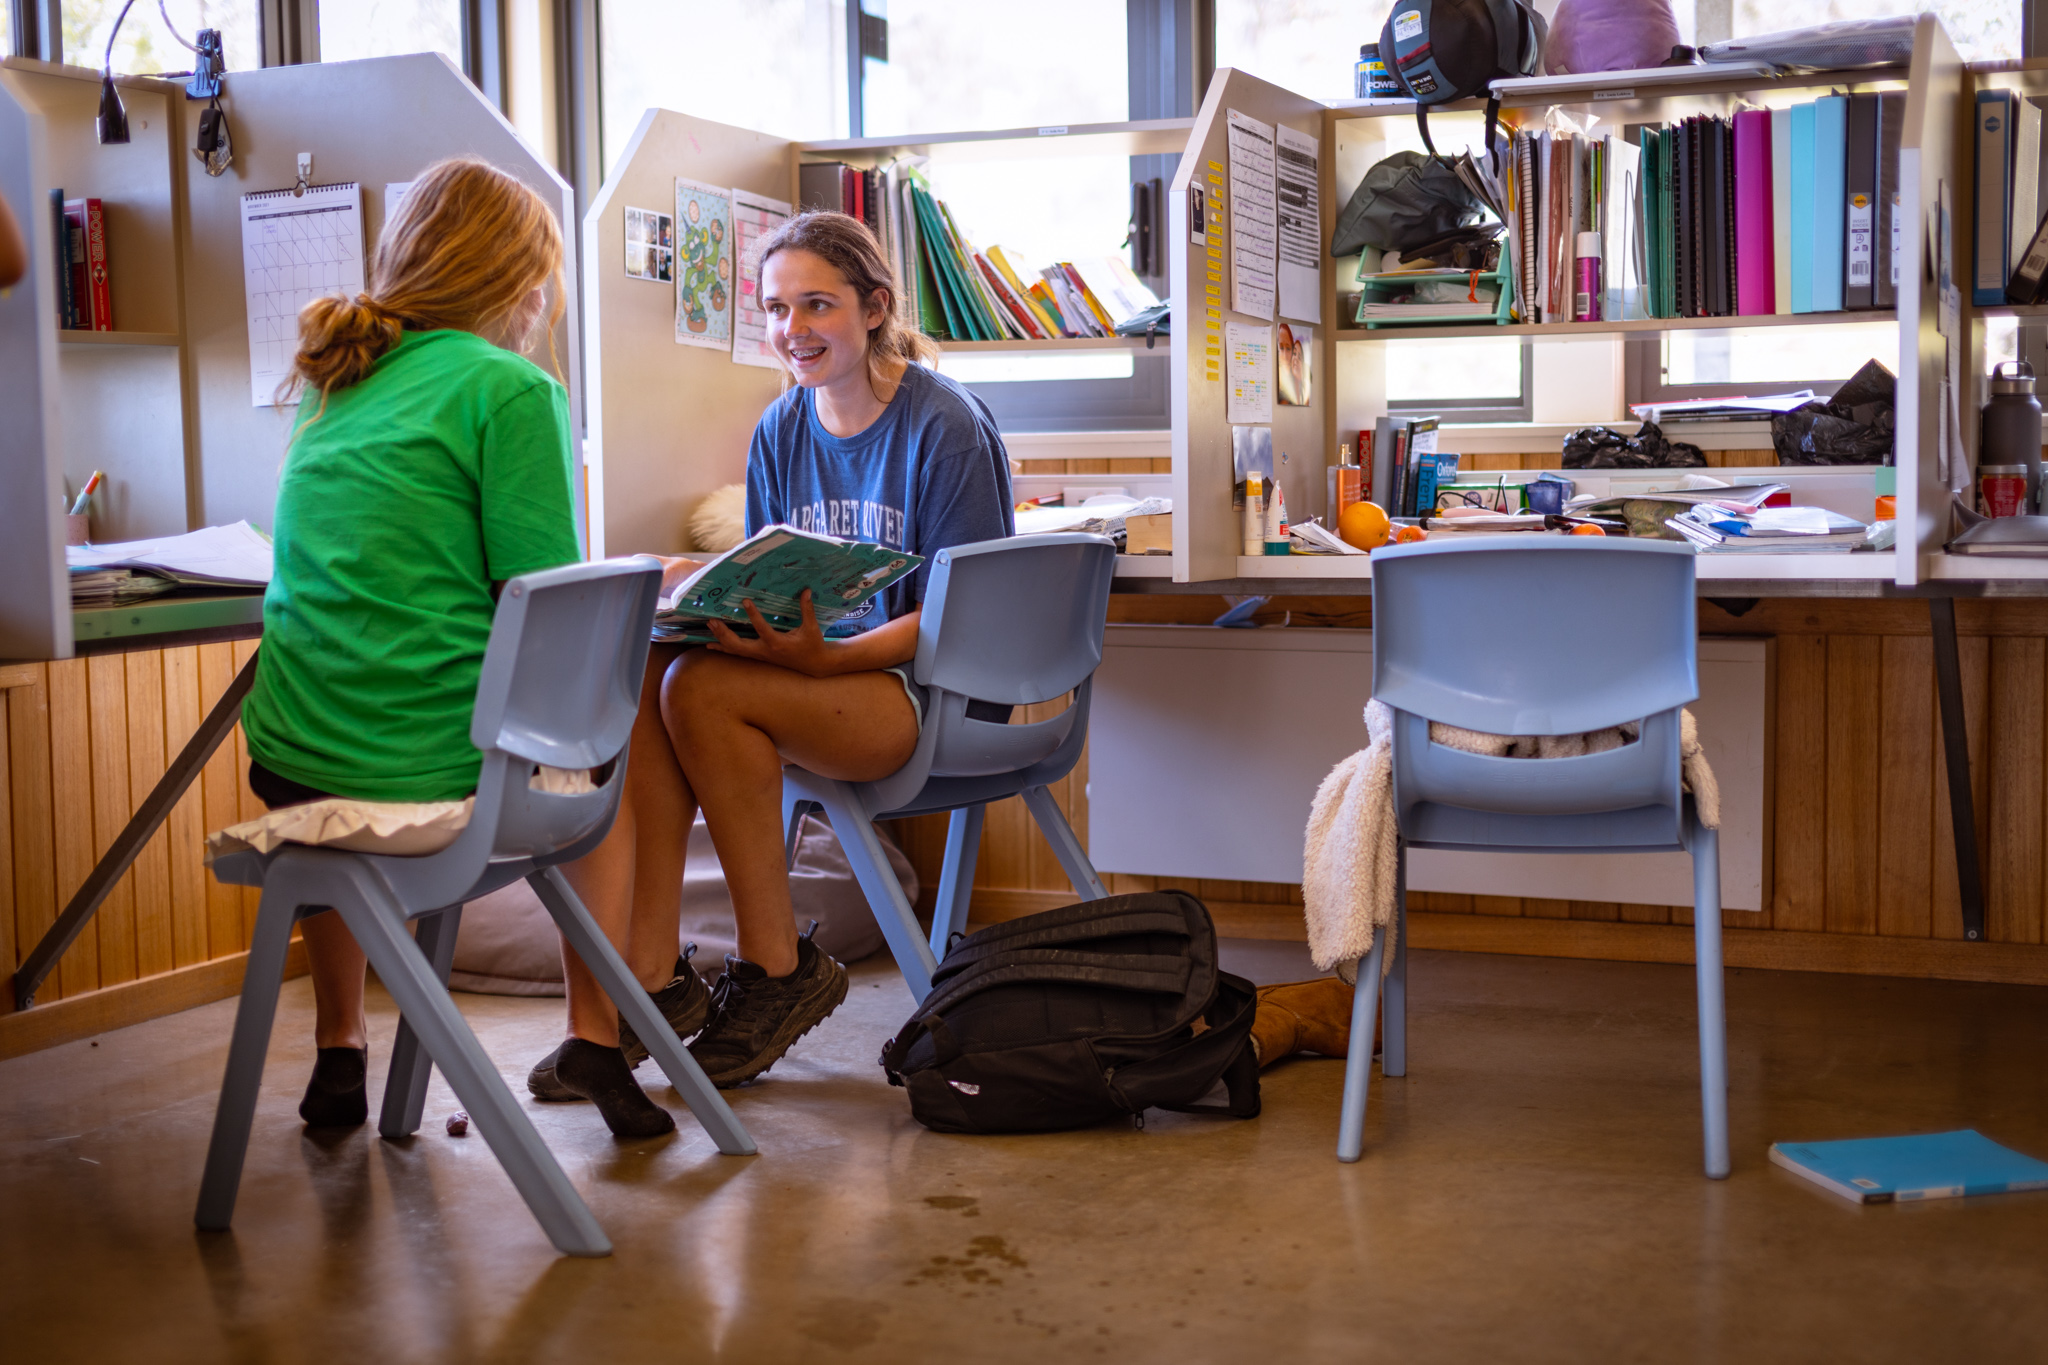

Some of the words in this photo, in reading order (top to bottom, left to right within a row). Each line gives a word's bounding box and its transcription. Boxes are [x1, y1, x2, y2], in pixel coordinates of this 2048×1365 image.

[90, 210, 104, 262] POWER
[1360, 441, 1370, 484] POWER
[1437, 461, 1457, 477] Oxford
[790, 499, 860, 536] ARGARET
[862, 499, 905, 547] RIVER
